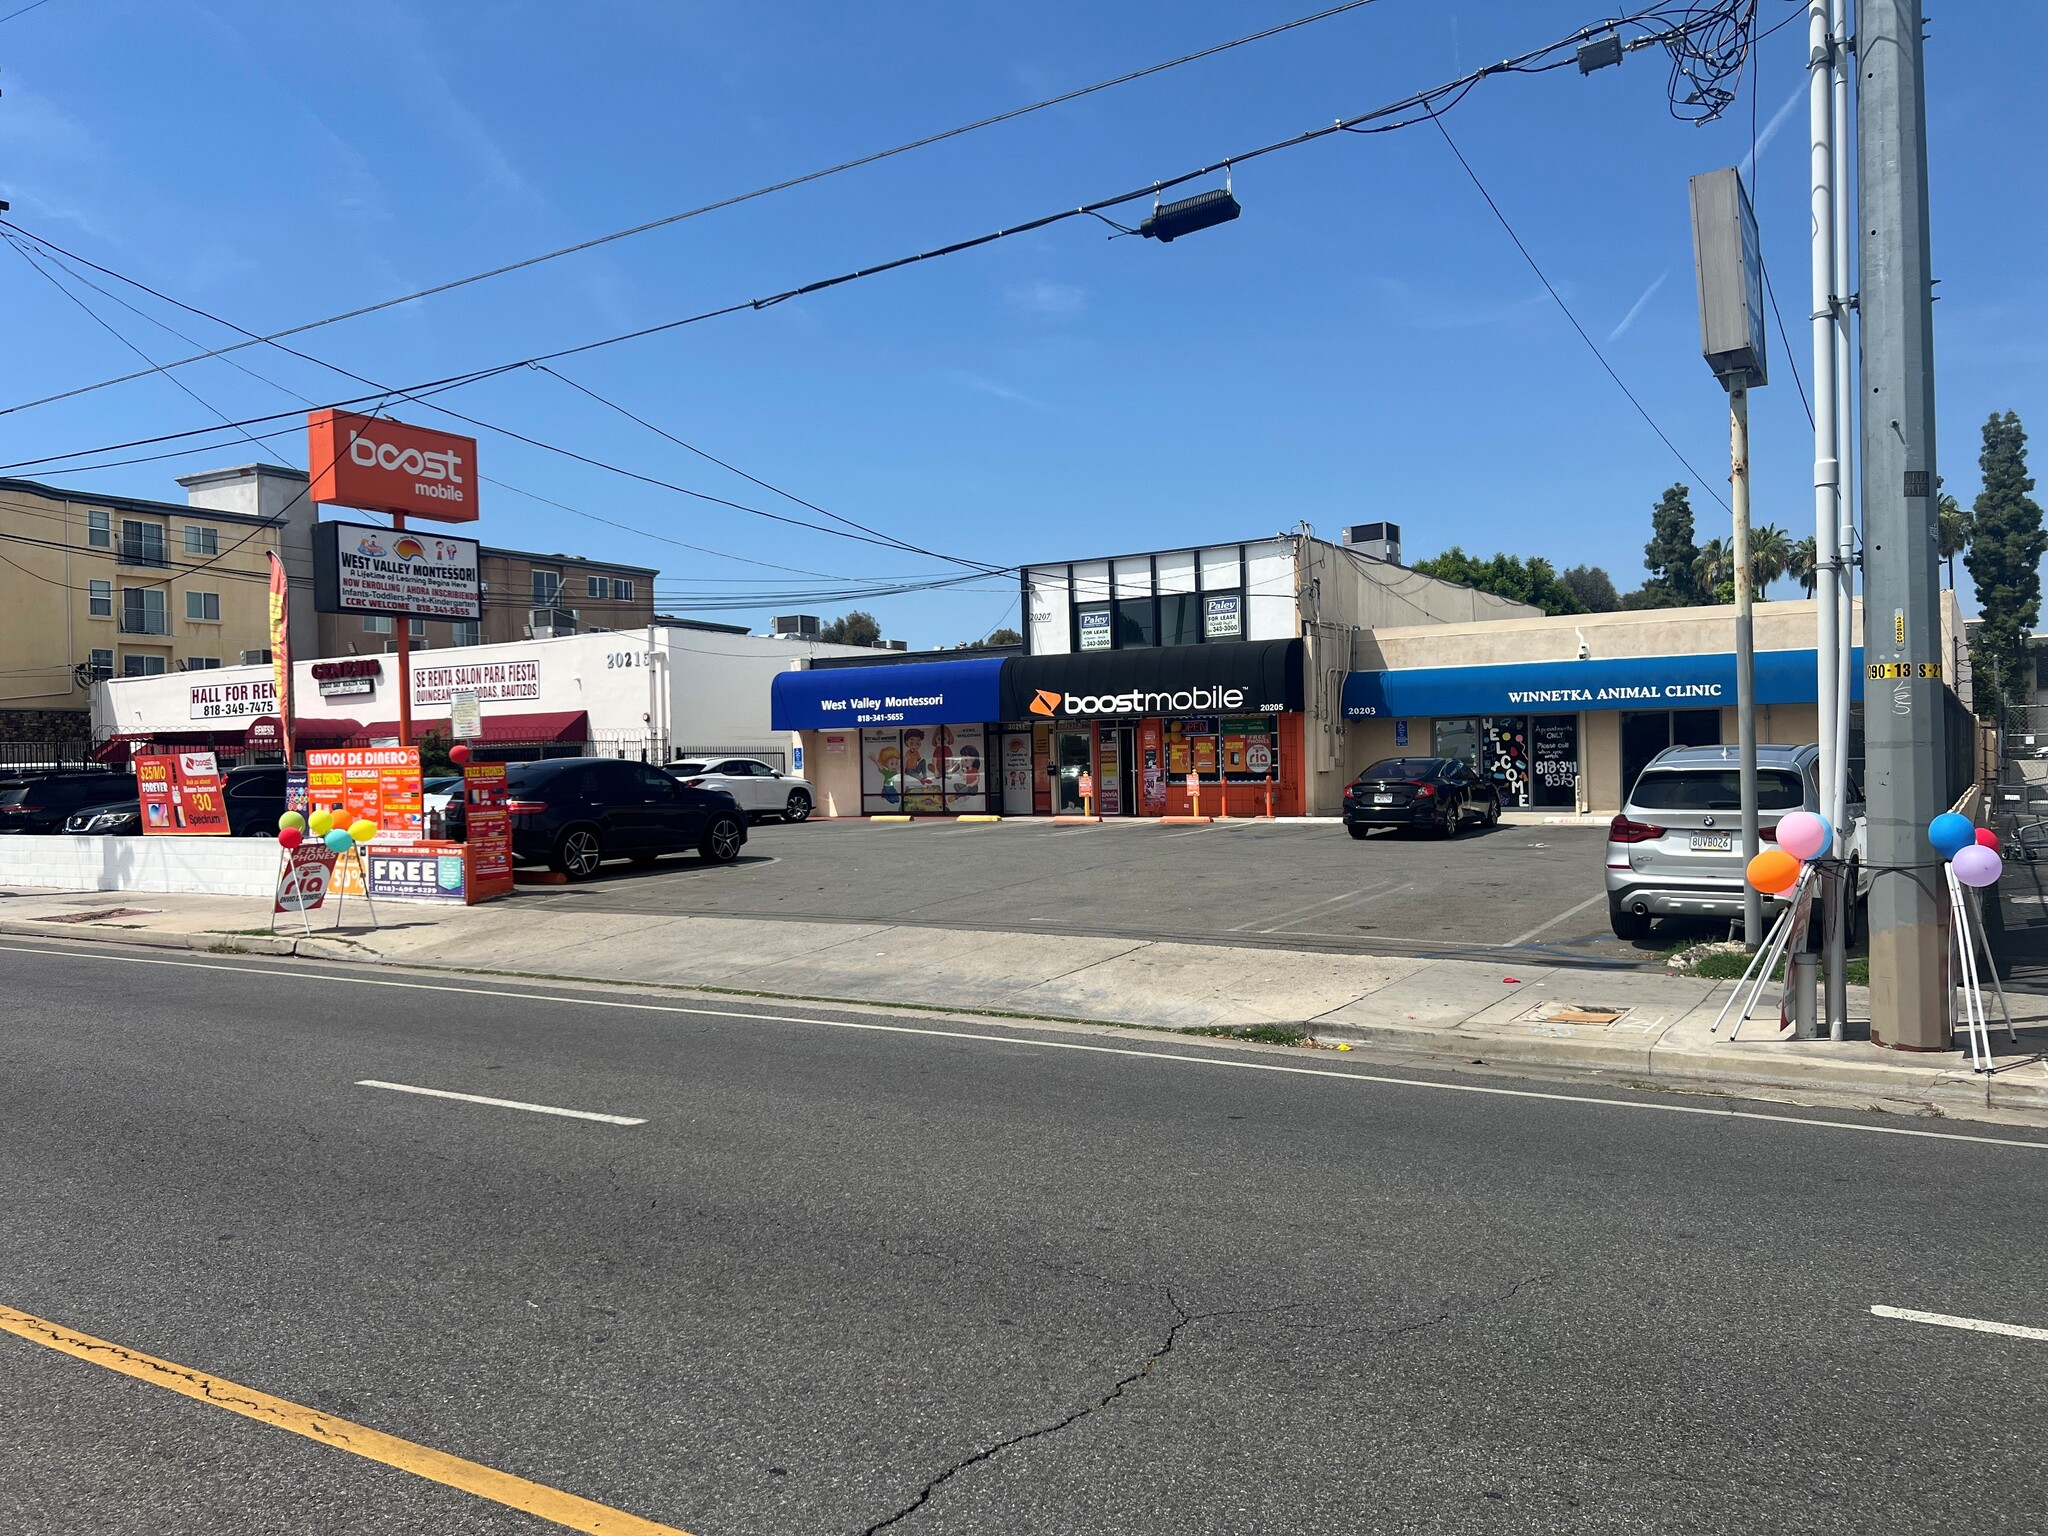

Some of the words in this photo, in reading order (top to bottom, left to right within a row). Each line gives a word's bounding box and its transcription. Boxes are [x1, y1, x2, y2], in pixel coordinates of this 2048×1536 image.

[350, 430, 462, 483] boost
[415, 483, 463, 501] mobile
[341, 551, 371, 570] WEST
[373, 559, 411, 575] VALLEY
[413, 564, 476, 582] MONTESSORI
[357, 570, 385, 580] Lifetime
[387, 573, 396, 581] of
[396, 574, 427, 585] Learning
[428, 578, 450, 588] Begins
[451, 581, 468, 589] Here
[343, 578, 360, 588] NOW
[362, 580, 401, 592] ENROLLING
[407, 586, 431, 596] AHORA
[432, 588, 480, 601] INSCRIBIENDO
[346, 597, 367, 606] CCRC
[368, 599, 411, 610] WELCOME
[416, 604, 471, 616] 818-341-5655
[1208, 600, 1237, 611] Paley
[1083, 615, 1109, 624] Paley
[607, 650, 650, 669] 20215
[311, 659, 380, 680] GENESIS
[416, 670, 426, 688] SE
[428, 669, 453, 687] RENTA
[455, 667, 482, 685] SALON
[484, 665, 507, 683] PARA
[508, 663, 537, 682] FIESTA
[192, 688, 221, 704] HALL
[225, 685, 248, 701] FOR
[253, 683, 277, 699] REN
[501, 683, 537, 698] BAUTIZOS
[1508, 688, 1592, 703] WINNETKA
[1597, 685, 1660, 700] ANIMAL
[1665, 683, 1722, 698] CLINIC
[204, 701, 274, 716] 818-349-7475
[821, 700, 847, 710] West
[850, 698, 881, 711] Valley
[885, 694, 943, 708] Montessori
[1260, 703, 1284, 712] 20205
[857, 713, 904, 722] 818-341-5655
[1348, 707, 1376, 716] 20203
[254, 725, 275, 736] GENESIS
[1181, 721, 1207, 733] OPEN
[195, 759, 213, 767] boost
[309, 752, 345, 765] ENVIOS
[348, 752, 363, 765] DE
[365, 751, 408, 765] DINERO
[1250, 749, 1268, 763] ria
[1482, 717, 1530, 807] WELCOME
[140, 765, 166, 781] $25/MO
[310, 773, 322, 785] FREE
[323, 772, 343, 785] PHONES
[346, 769, 379, 779] RECARGAS
[464, 767, 480, 778] FREE
[481, 765, 506, 777] PHONES
[142, 781, 168, 793] FOREVER
[1545, 773, 1575, 787] 8373
[183, 785, 197, 793] Home
[197, 785, 218, 793] Internet
[192, 793, 212, 812] $30
[189, 814, 221, 826] Spectrum
[1692, 837, 1728, 848] 8UVB026
[292, 852, 337, 861] PHONES
[333, 868, 366, 888] 50%
[374, 860, 436, 882] FREE
[284, 870, 323, 896] ria
[280, 894, 296, 903] ENVIO
